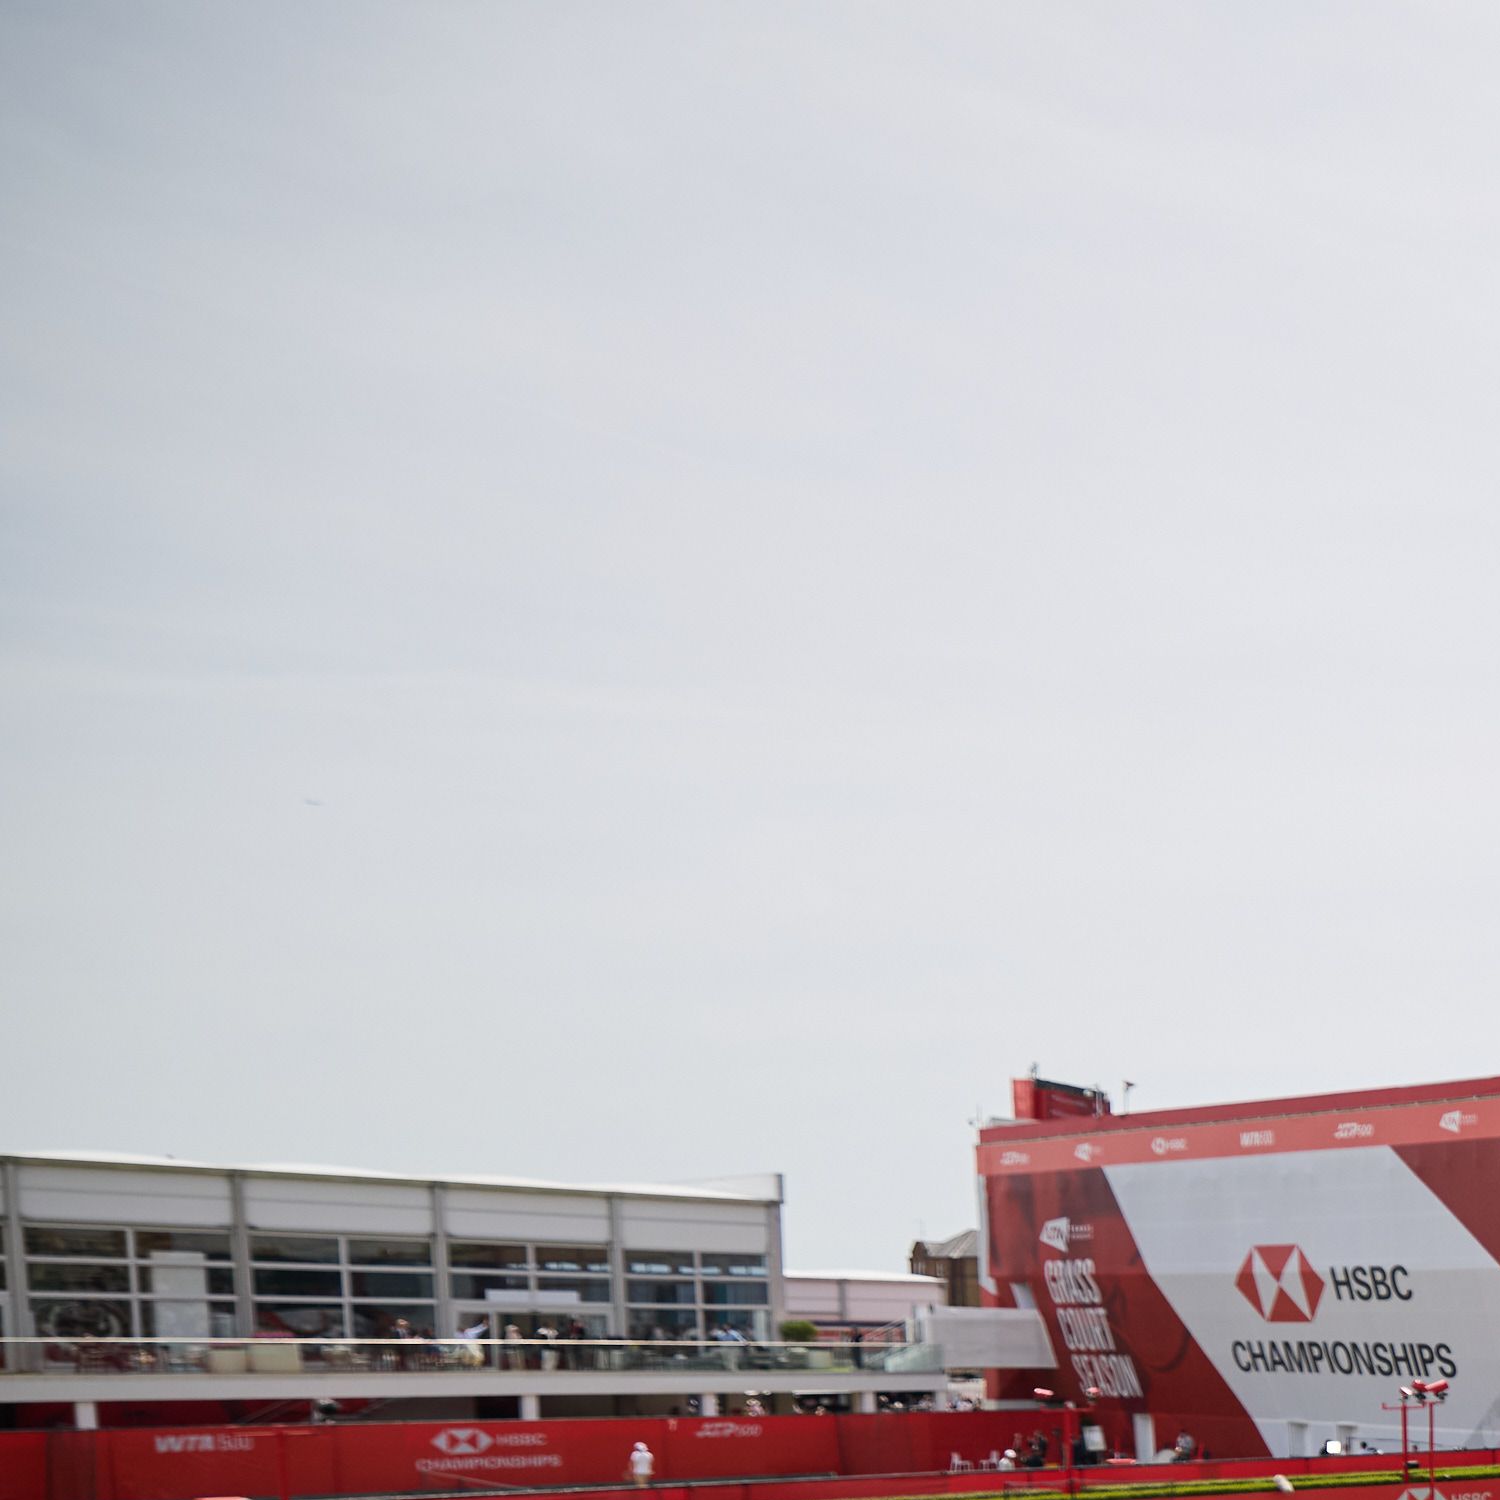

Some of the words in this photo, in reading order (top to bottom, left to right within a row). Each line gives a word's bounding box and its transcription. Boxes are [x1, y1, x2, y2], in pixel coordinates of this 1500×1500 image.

[1044, 1258, 1103, 1304] GRASS
[1329, 1264, 1413, 1301] HSBC
[1056, 1306, 1117, 1351] COURT
[1071, 1354, 1145, 1398] SEASON
[1231, 1340, 1458, 1378] CHAMPIONSHIPS
